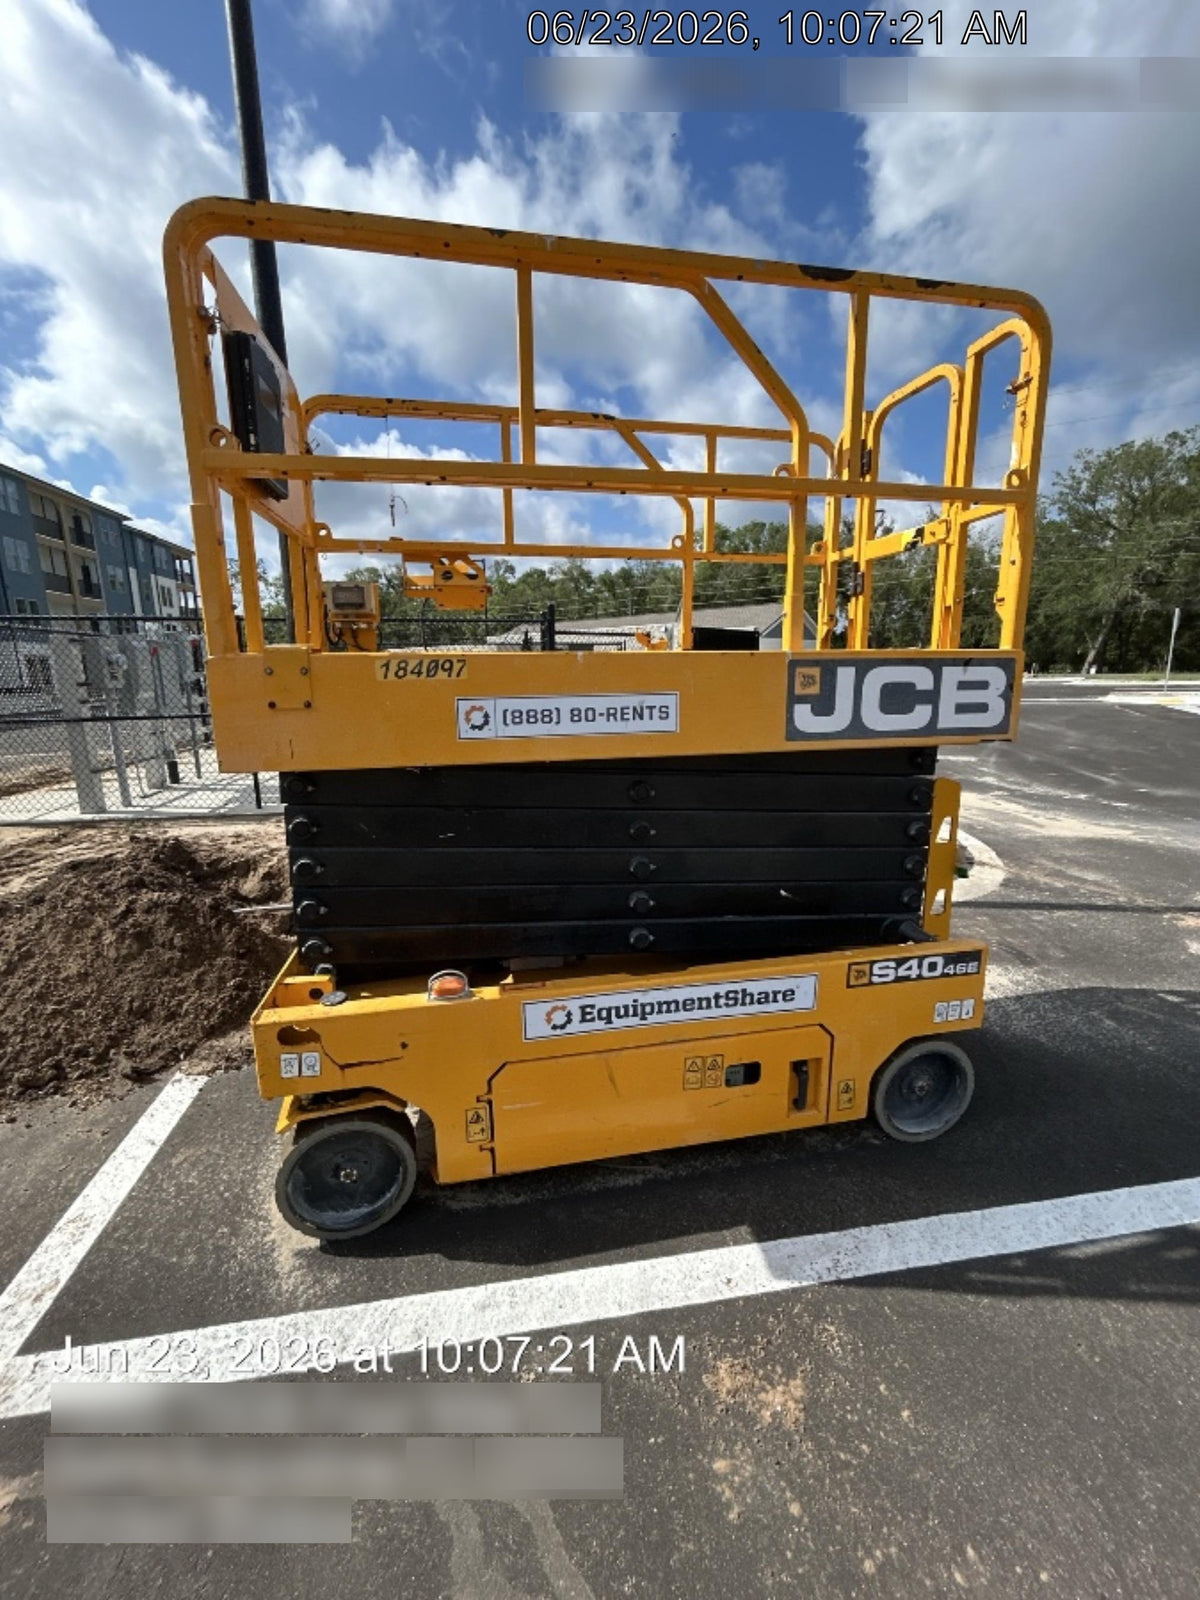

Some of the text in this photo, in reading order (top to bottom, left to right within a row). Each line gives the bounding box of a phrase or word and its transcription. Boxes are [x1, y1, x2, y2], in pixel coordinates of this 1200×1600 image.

[380, 658, 467, 680] 184097
[793, 665, 1008, 733] JCB
[502, 705, 670, 726] (888) 80-RENTS
[578, 986, 797, 1025] EquipmentShare
